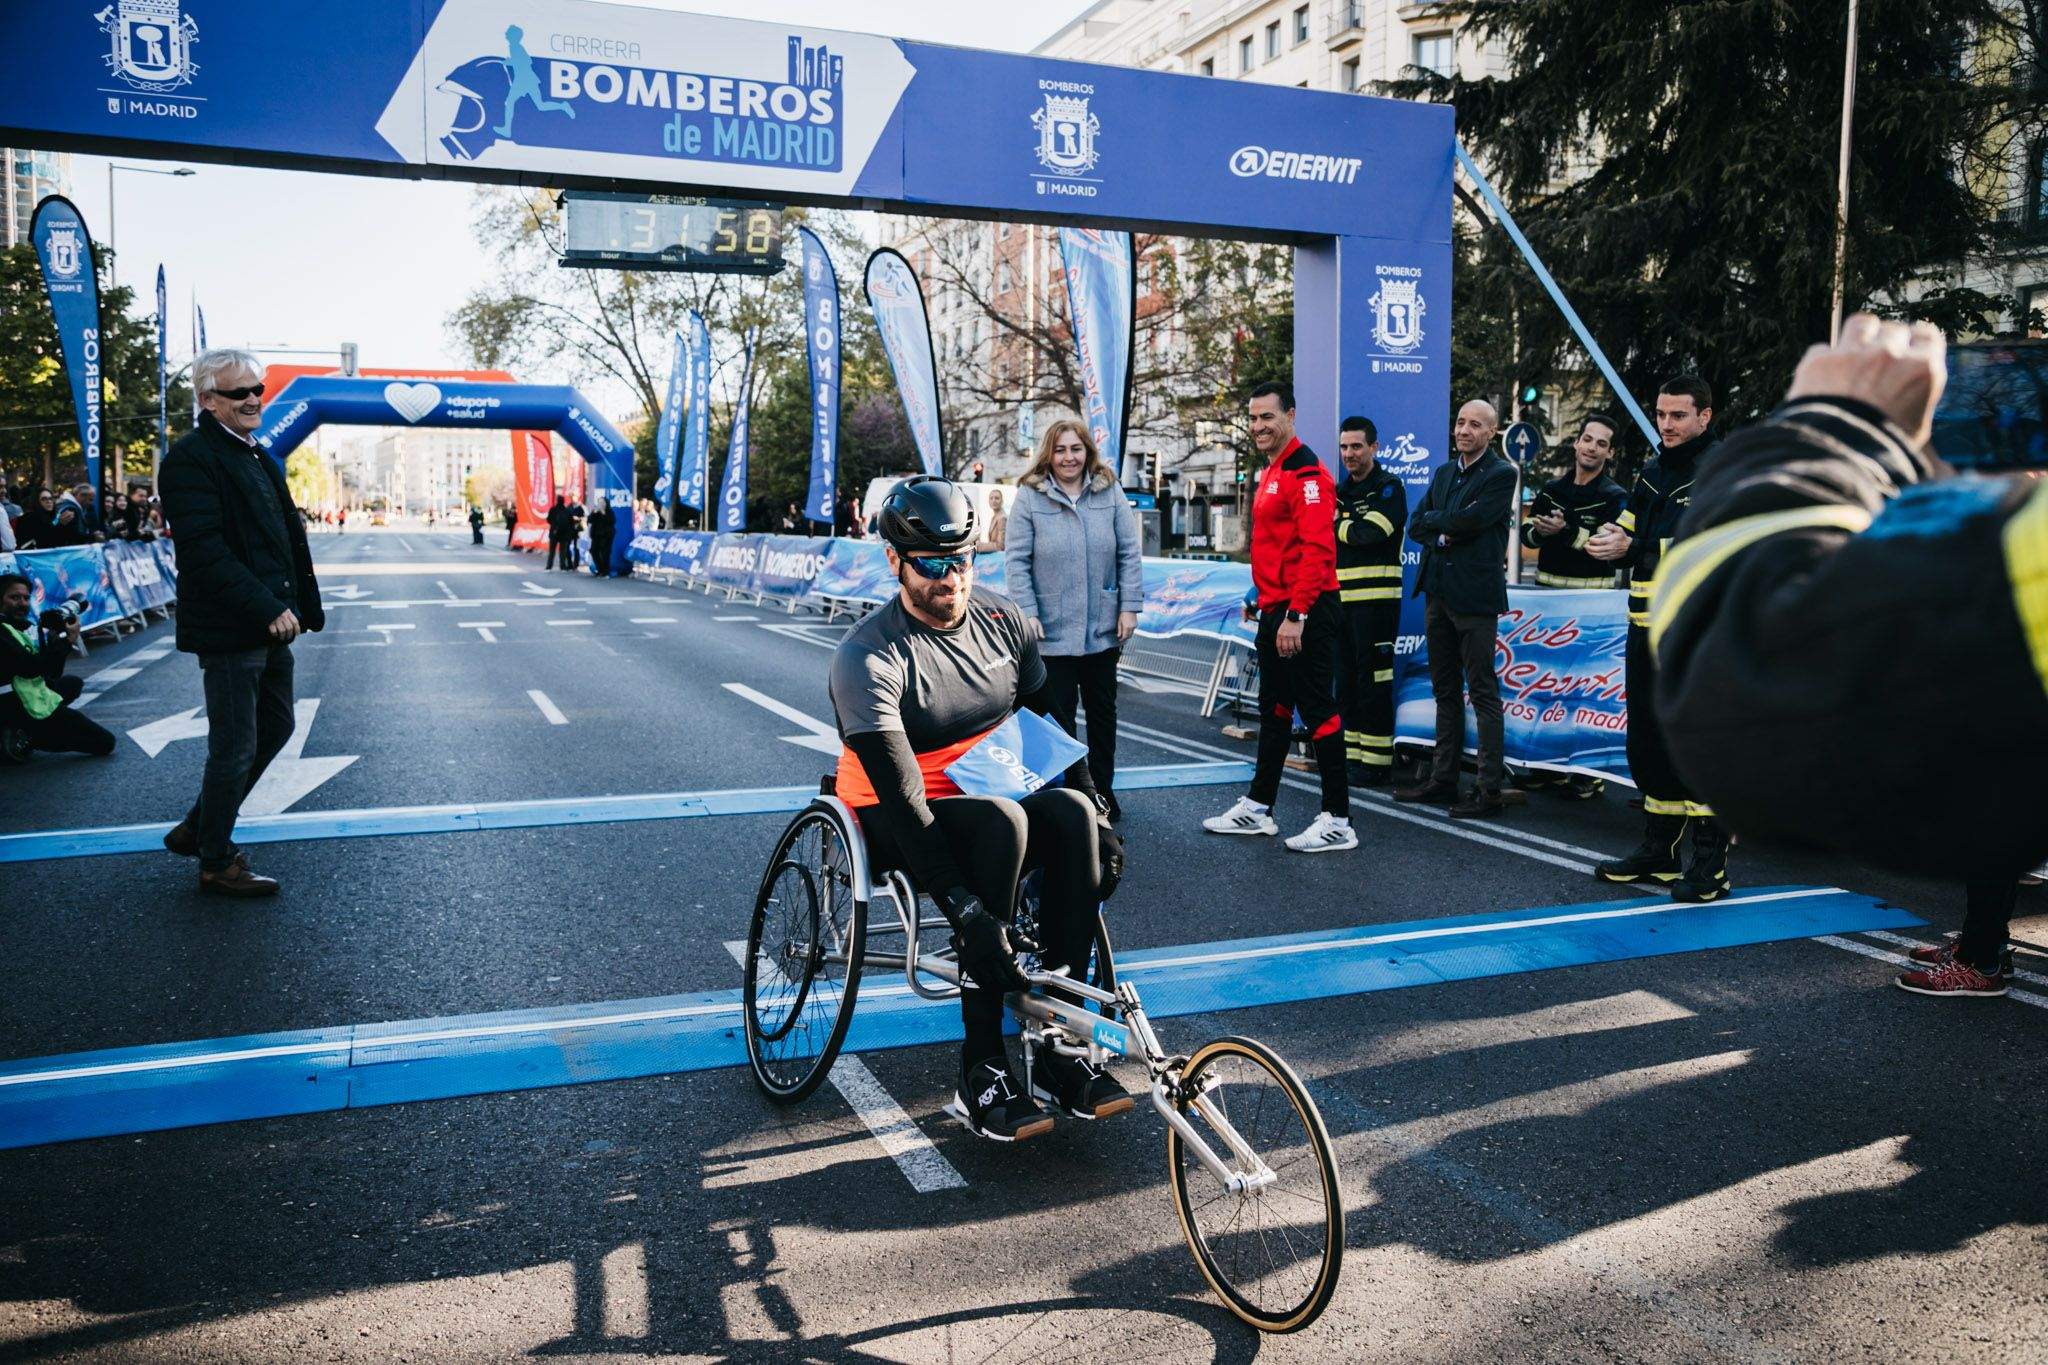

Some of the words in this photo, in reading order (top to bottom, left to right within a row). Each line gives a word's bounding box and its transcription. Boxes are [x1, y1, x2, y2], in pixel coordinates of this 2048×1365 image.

[550, 34, 641, 60] CARRERA
[550, 60, 834, 125] BOMBEROS
[1039, 79, 1094, 94] BOMBEROS
[130, 101, 198, 118] MADRID
[663, 113, 702, 154] de
[714, 117, 835, 166] MADRID
[1266, 150, 1362, 184] ENERVIT
[1051, 183, 1097, 197] MADRID
[601, 251, 620, 260] hour
[1375, 265, 1421, 277] BOMBEROS
[1384, 362, 1422, 373] MADRID
[270, 401, 309, 438] MADRID
[578, 418, 614, 453] MADRID
[1542, 703, 1566, 722] de
